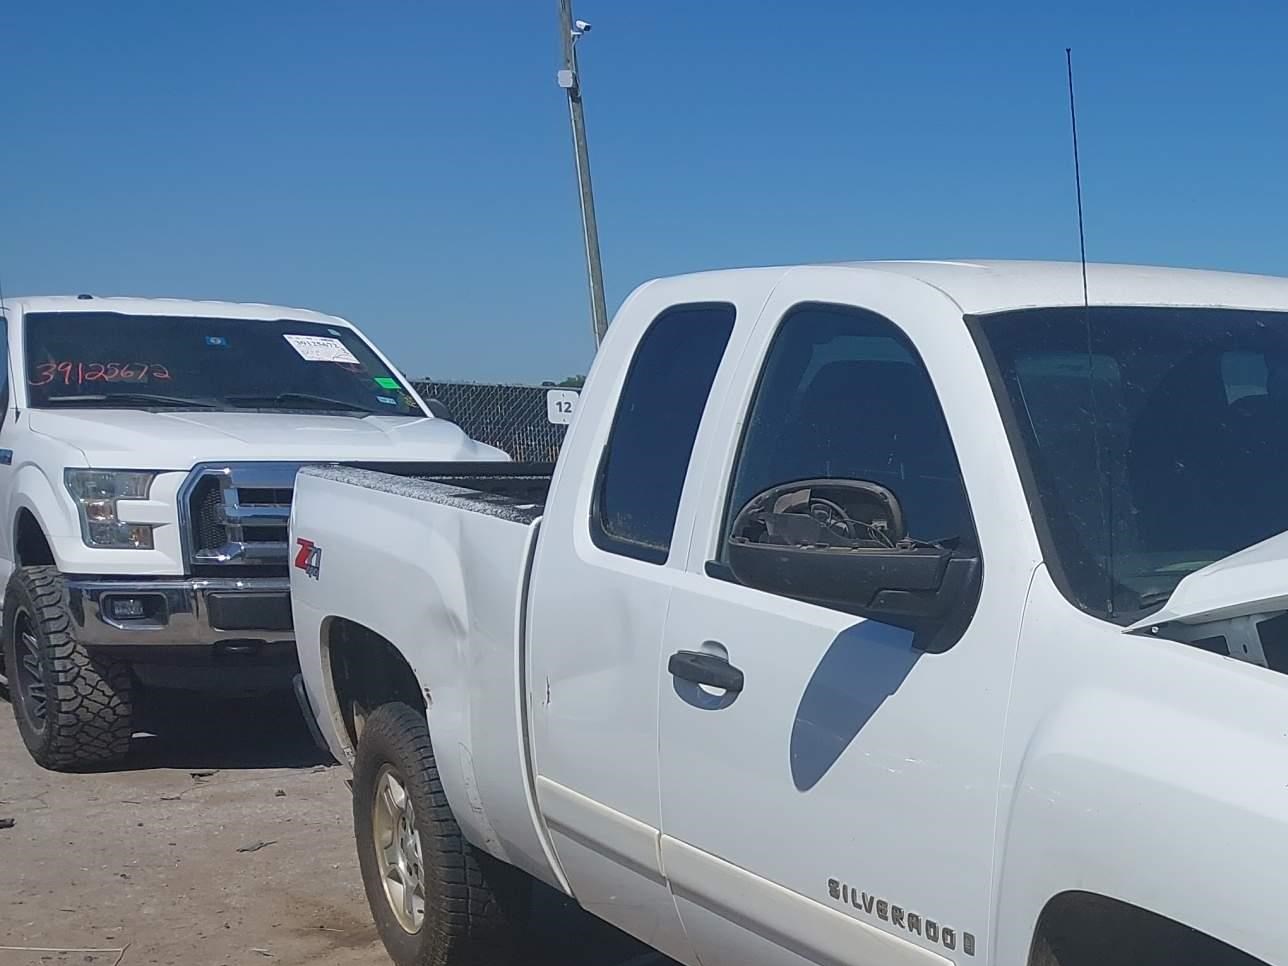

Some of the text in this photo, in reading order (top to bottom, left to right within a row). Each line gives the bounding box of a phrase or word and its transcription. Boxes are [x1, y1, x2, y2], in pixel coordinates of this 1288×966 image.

[29, 361, 171, 386] 39125672
[555, 401, 573, 414] 12
[828, 878, 956, 951] SILVERADO
